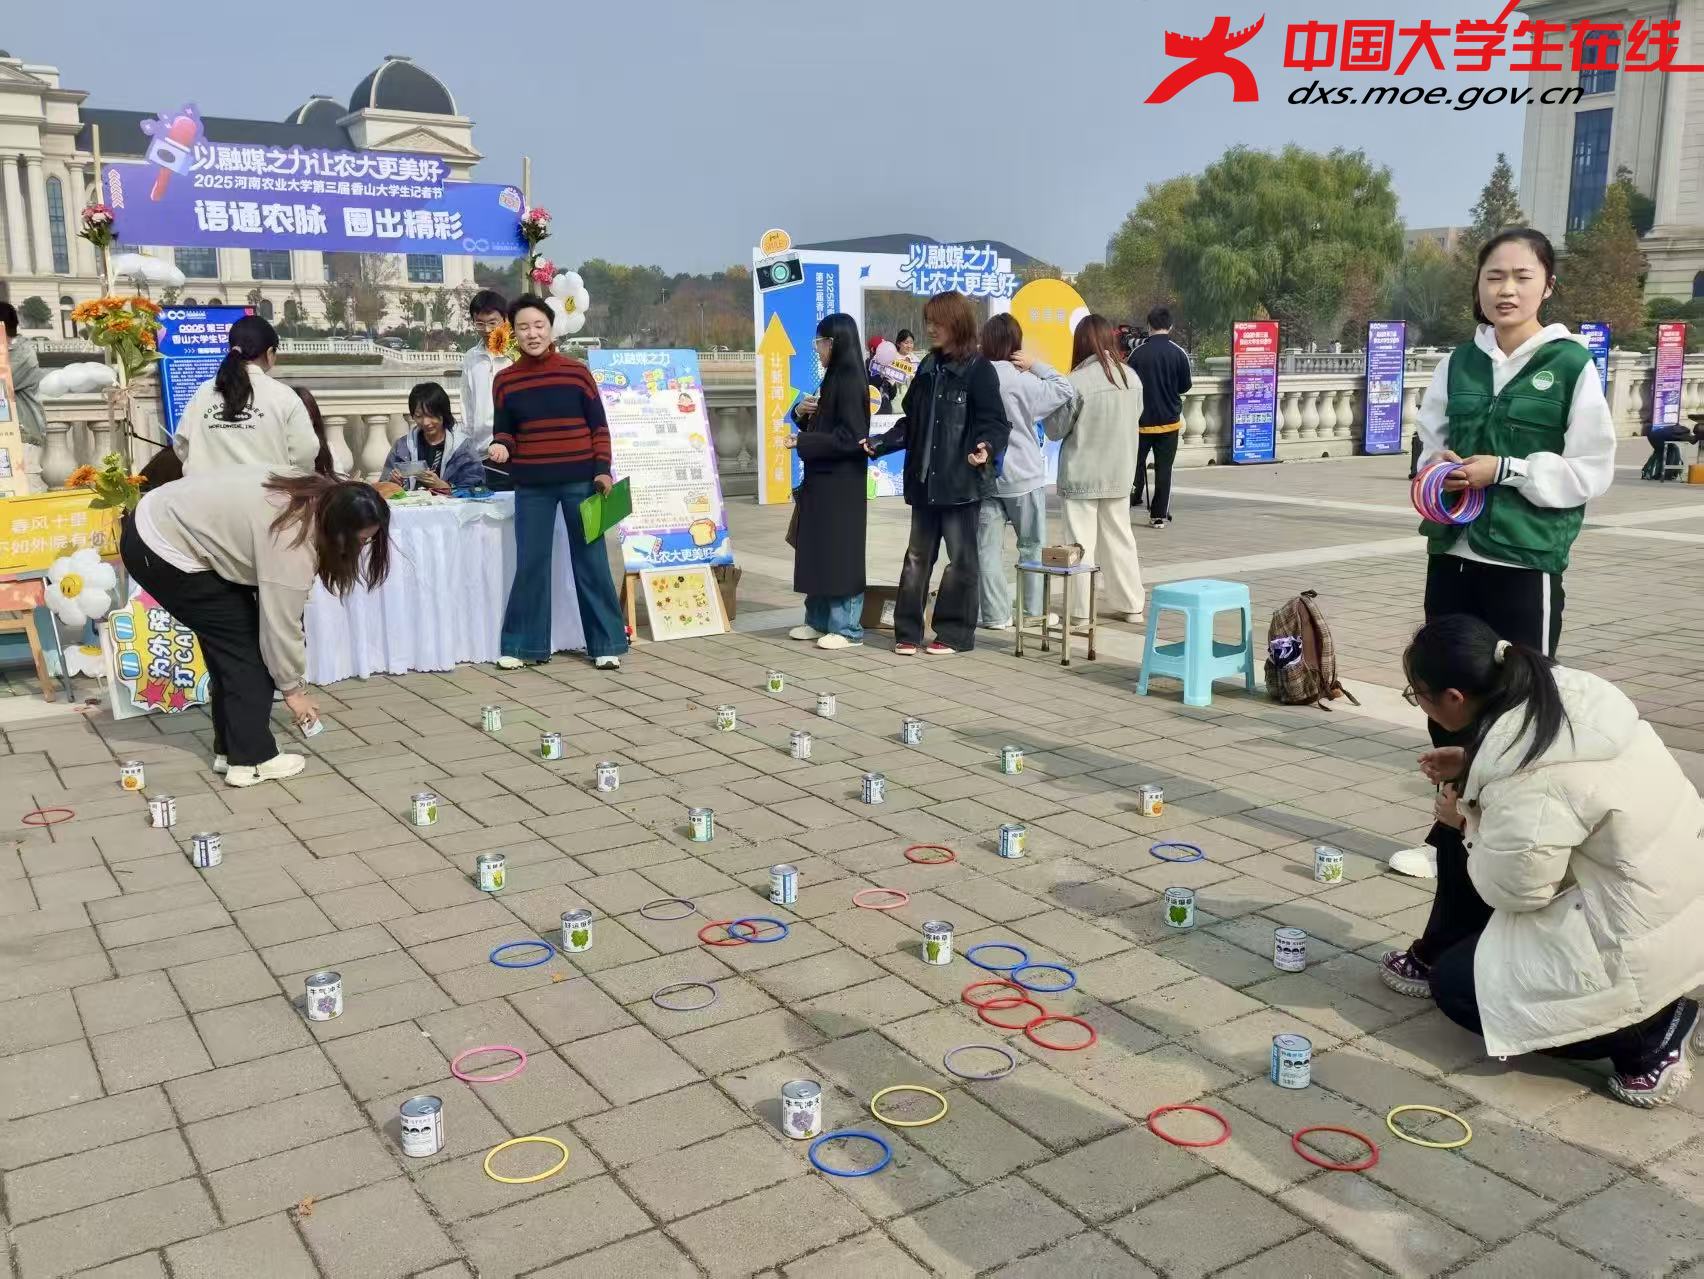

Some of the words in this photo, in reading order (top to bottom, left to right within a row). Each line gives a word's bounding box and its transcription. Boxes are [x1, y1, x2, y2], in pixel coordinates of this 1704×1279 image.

[190, 144, 445, 183] 以融媒之力让农大更美好
[194, 173, 444, 199] 2025河南农业大学第三届香山大学生记者节
[194, 200, 328, 236] 语通农脉
[343, 207, 464, 240] 圈出精彩
[900, 244, 999, 272] 以融媒之力
[896, 271, 1019, 297] 让农大更美好
[609, 351, 671, 367] 以融媒之力
